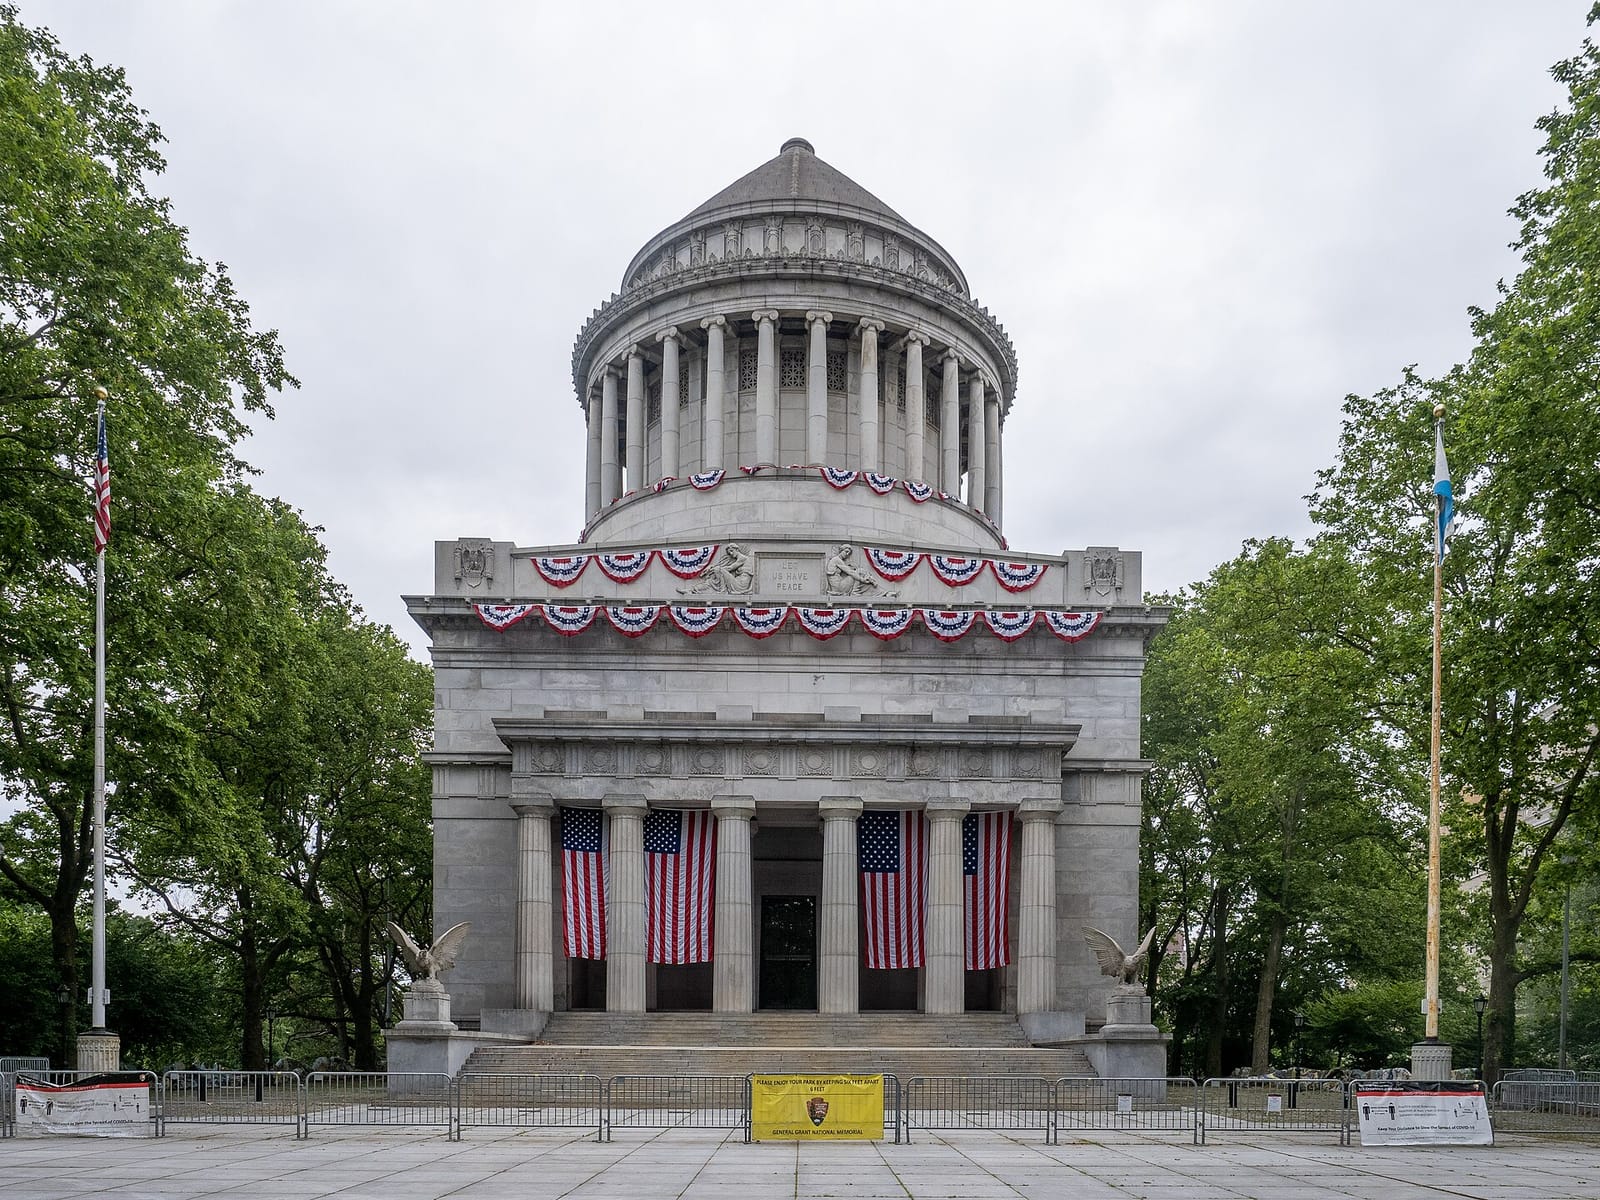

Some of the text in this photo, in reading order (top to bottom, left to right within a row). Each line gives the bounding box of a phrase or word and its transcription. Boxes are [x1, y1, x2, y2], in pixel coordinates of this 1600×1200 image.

[773, 572, 808, 581] US HAVE
[776, 582, 803, 591] PEACE
